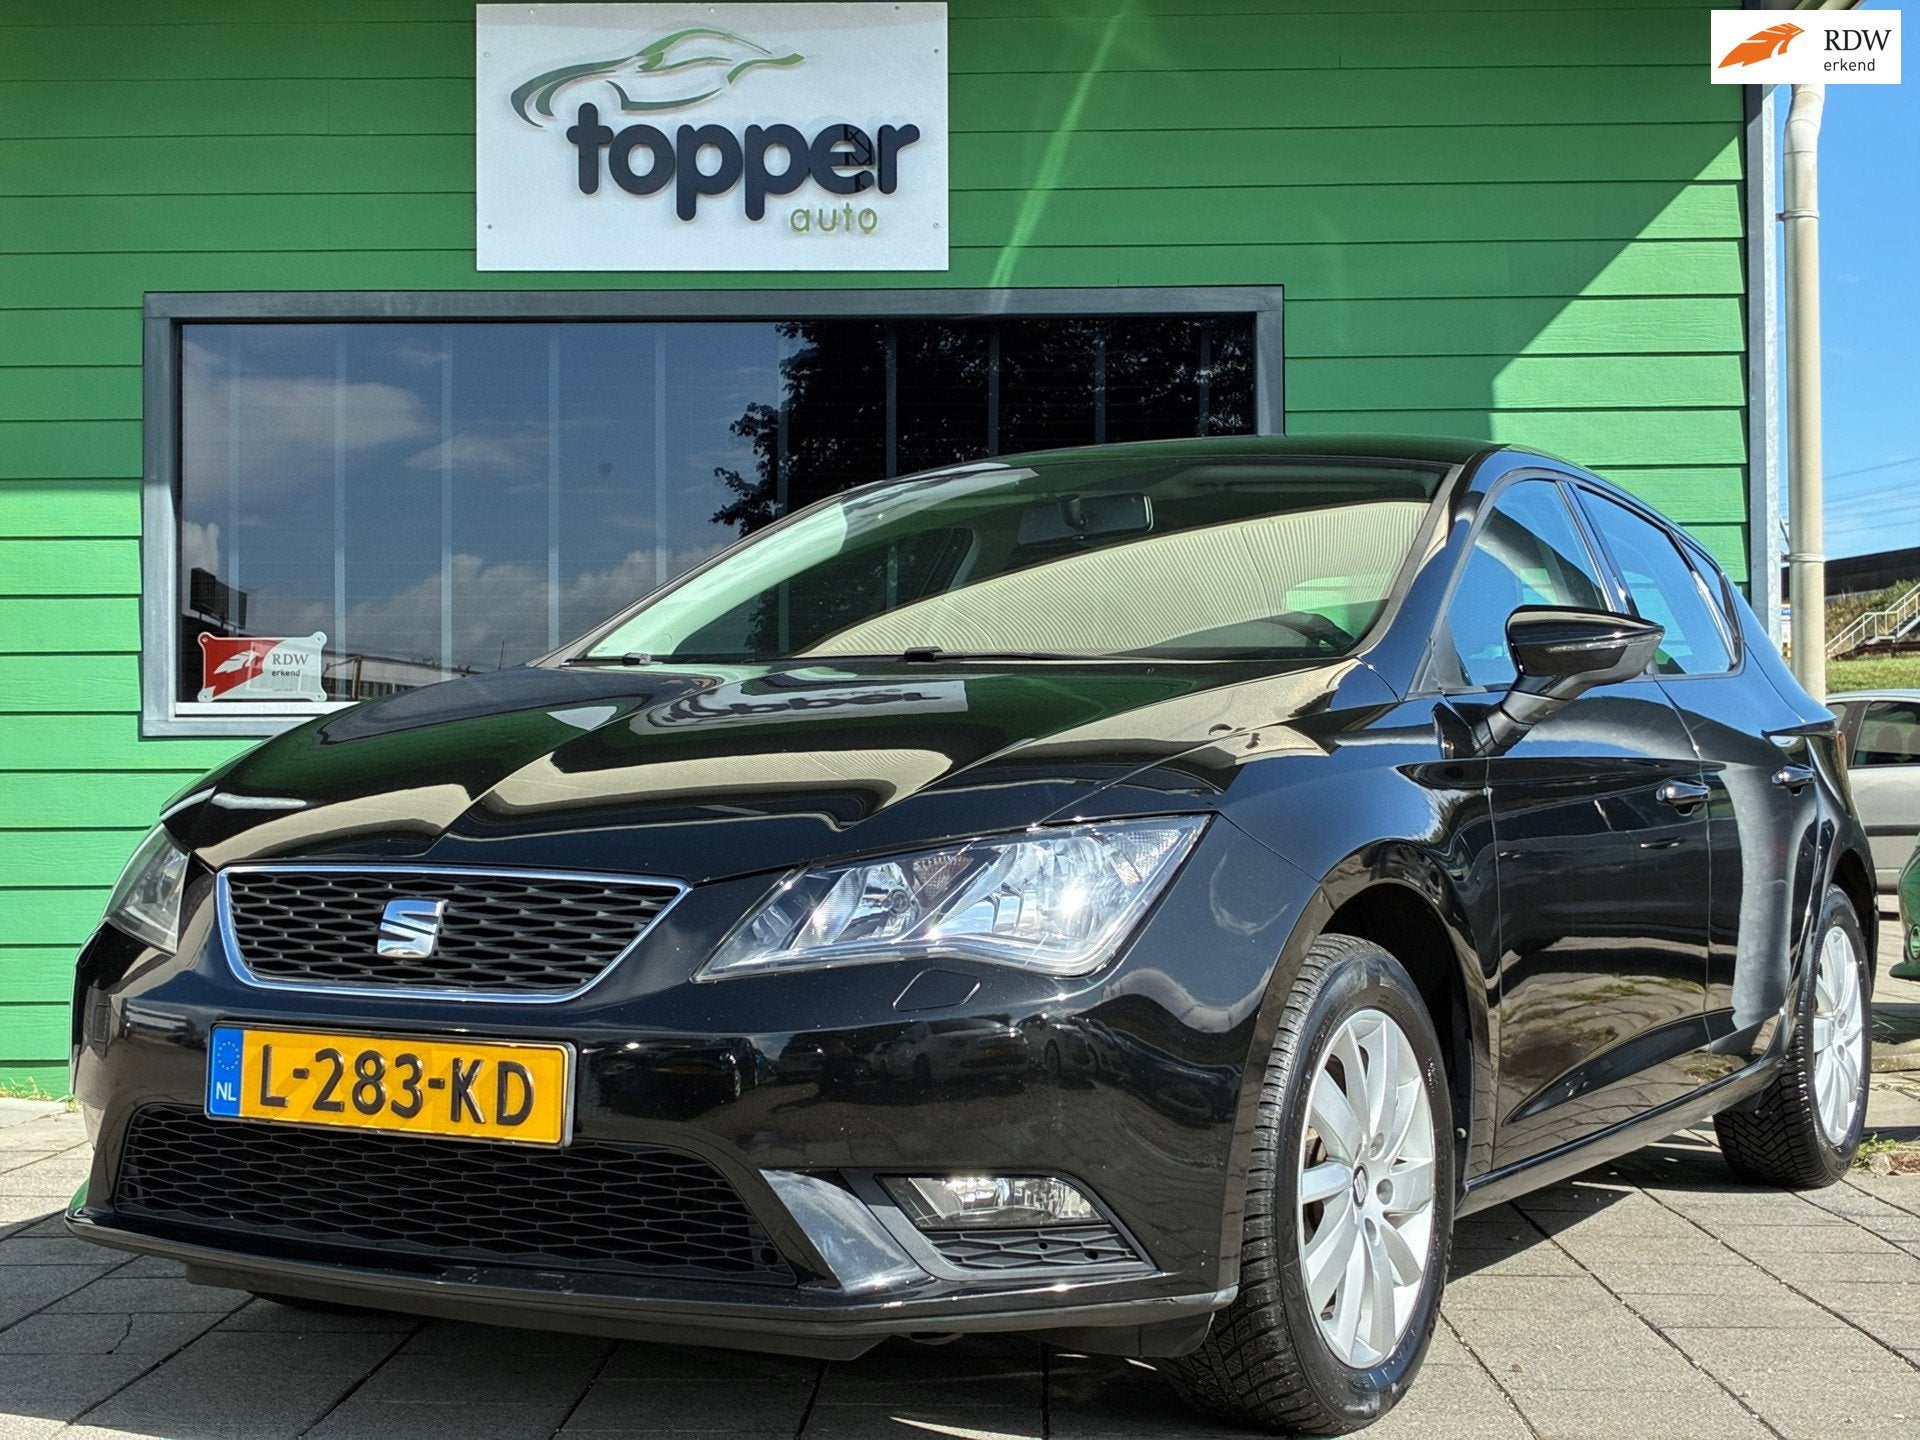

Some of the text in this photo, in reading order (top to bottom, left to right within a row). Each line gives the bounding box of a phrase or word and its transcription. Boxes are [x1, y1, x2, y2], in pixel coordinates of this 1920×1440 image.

[566, 102, 921, 222] topper
[789, 202, 879, 235] auto
[270, 668, 302, 678] erkend
[271, 653, 310, 666] RDW
[215, 1081, 238, 1102] NL
[259, 1043, 536, 1126] L-283-KD
